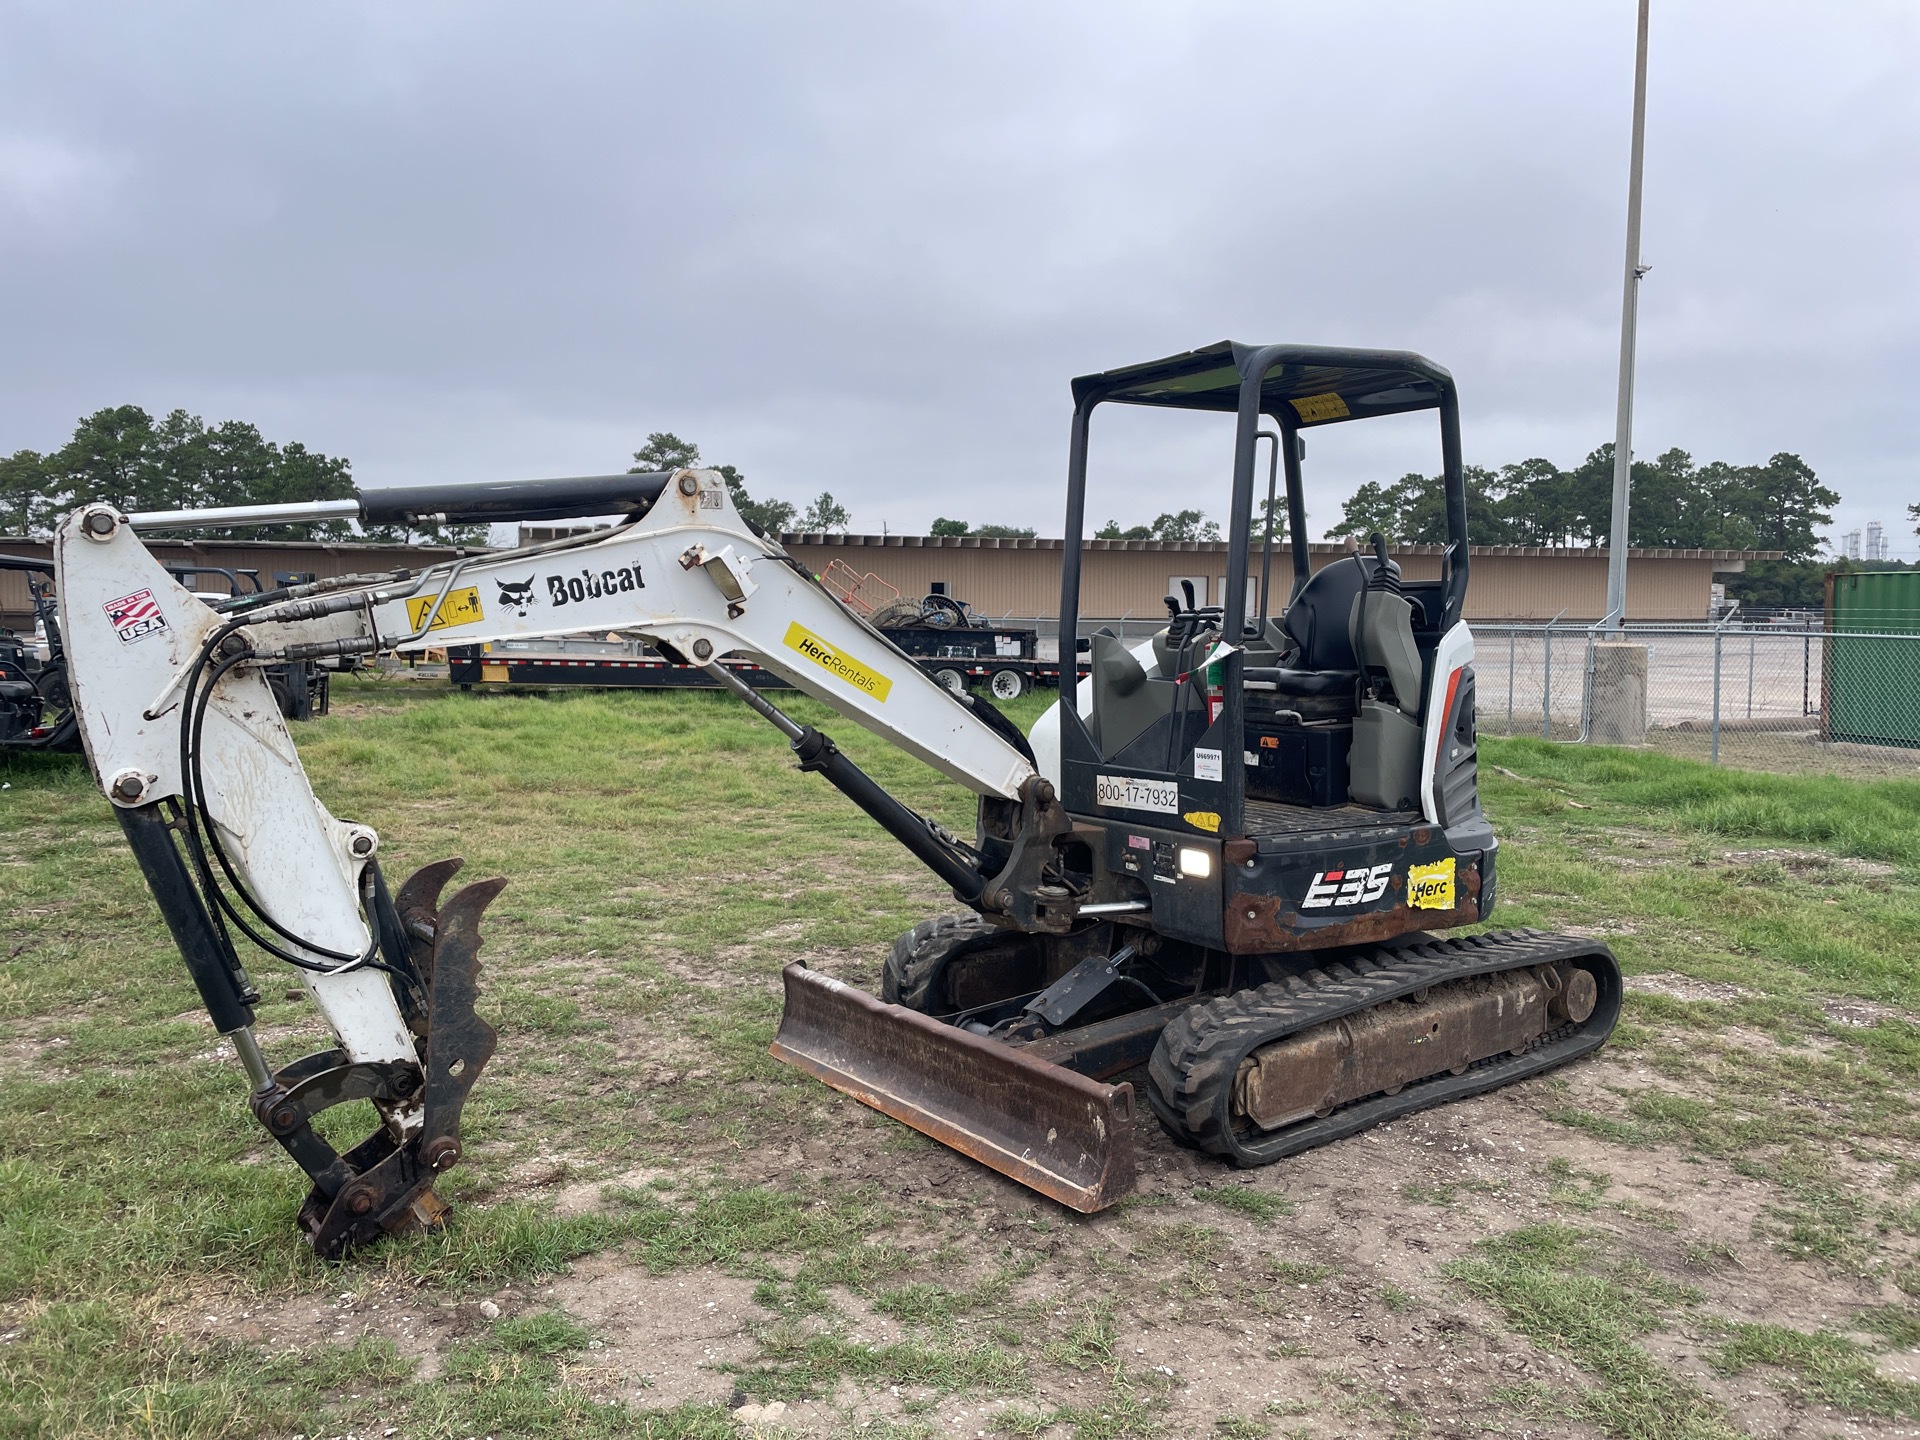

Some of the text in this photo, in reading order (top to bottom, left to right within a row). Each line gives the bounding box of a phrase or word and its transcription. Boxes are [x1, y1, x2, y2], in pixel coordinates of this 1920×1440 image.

[546, 560, 646, 607] Bobcat
[106, 591, 149, 611] MADE IN THE
[120, 617, 164, 641] USA
[1196, 752, 1221, 761] U669971
[1098, 783, 1177, 808] 800-17-7932
[1301, 862, 1393, 909] E35
[1416, 881, 1448, 898] Herc
